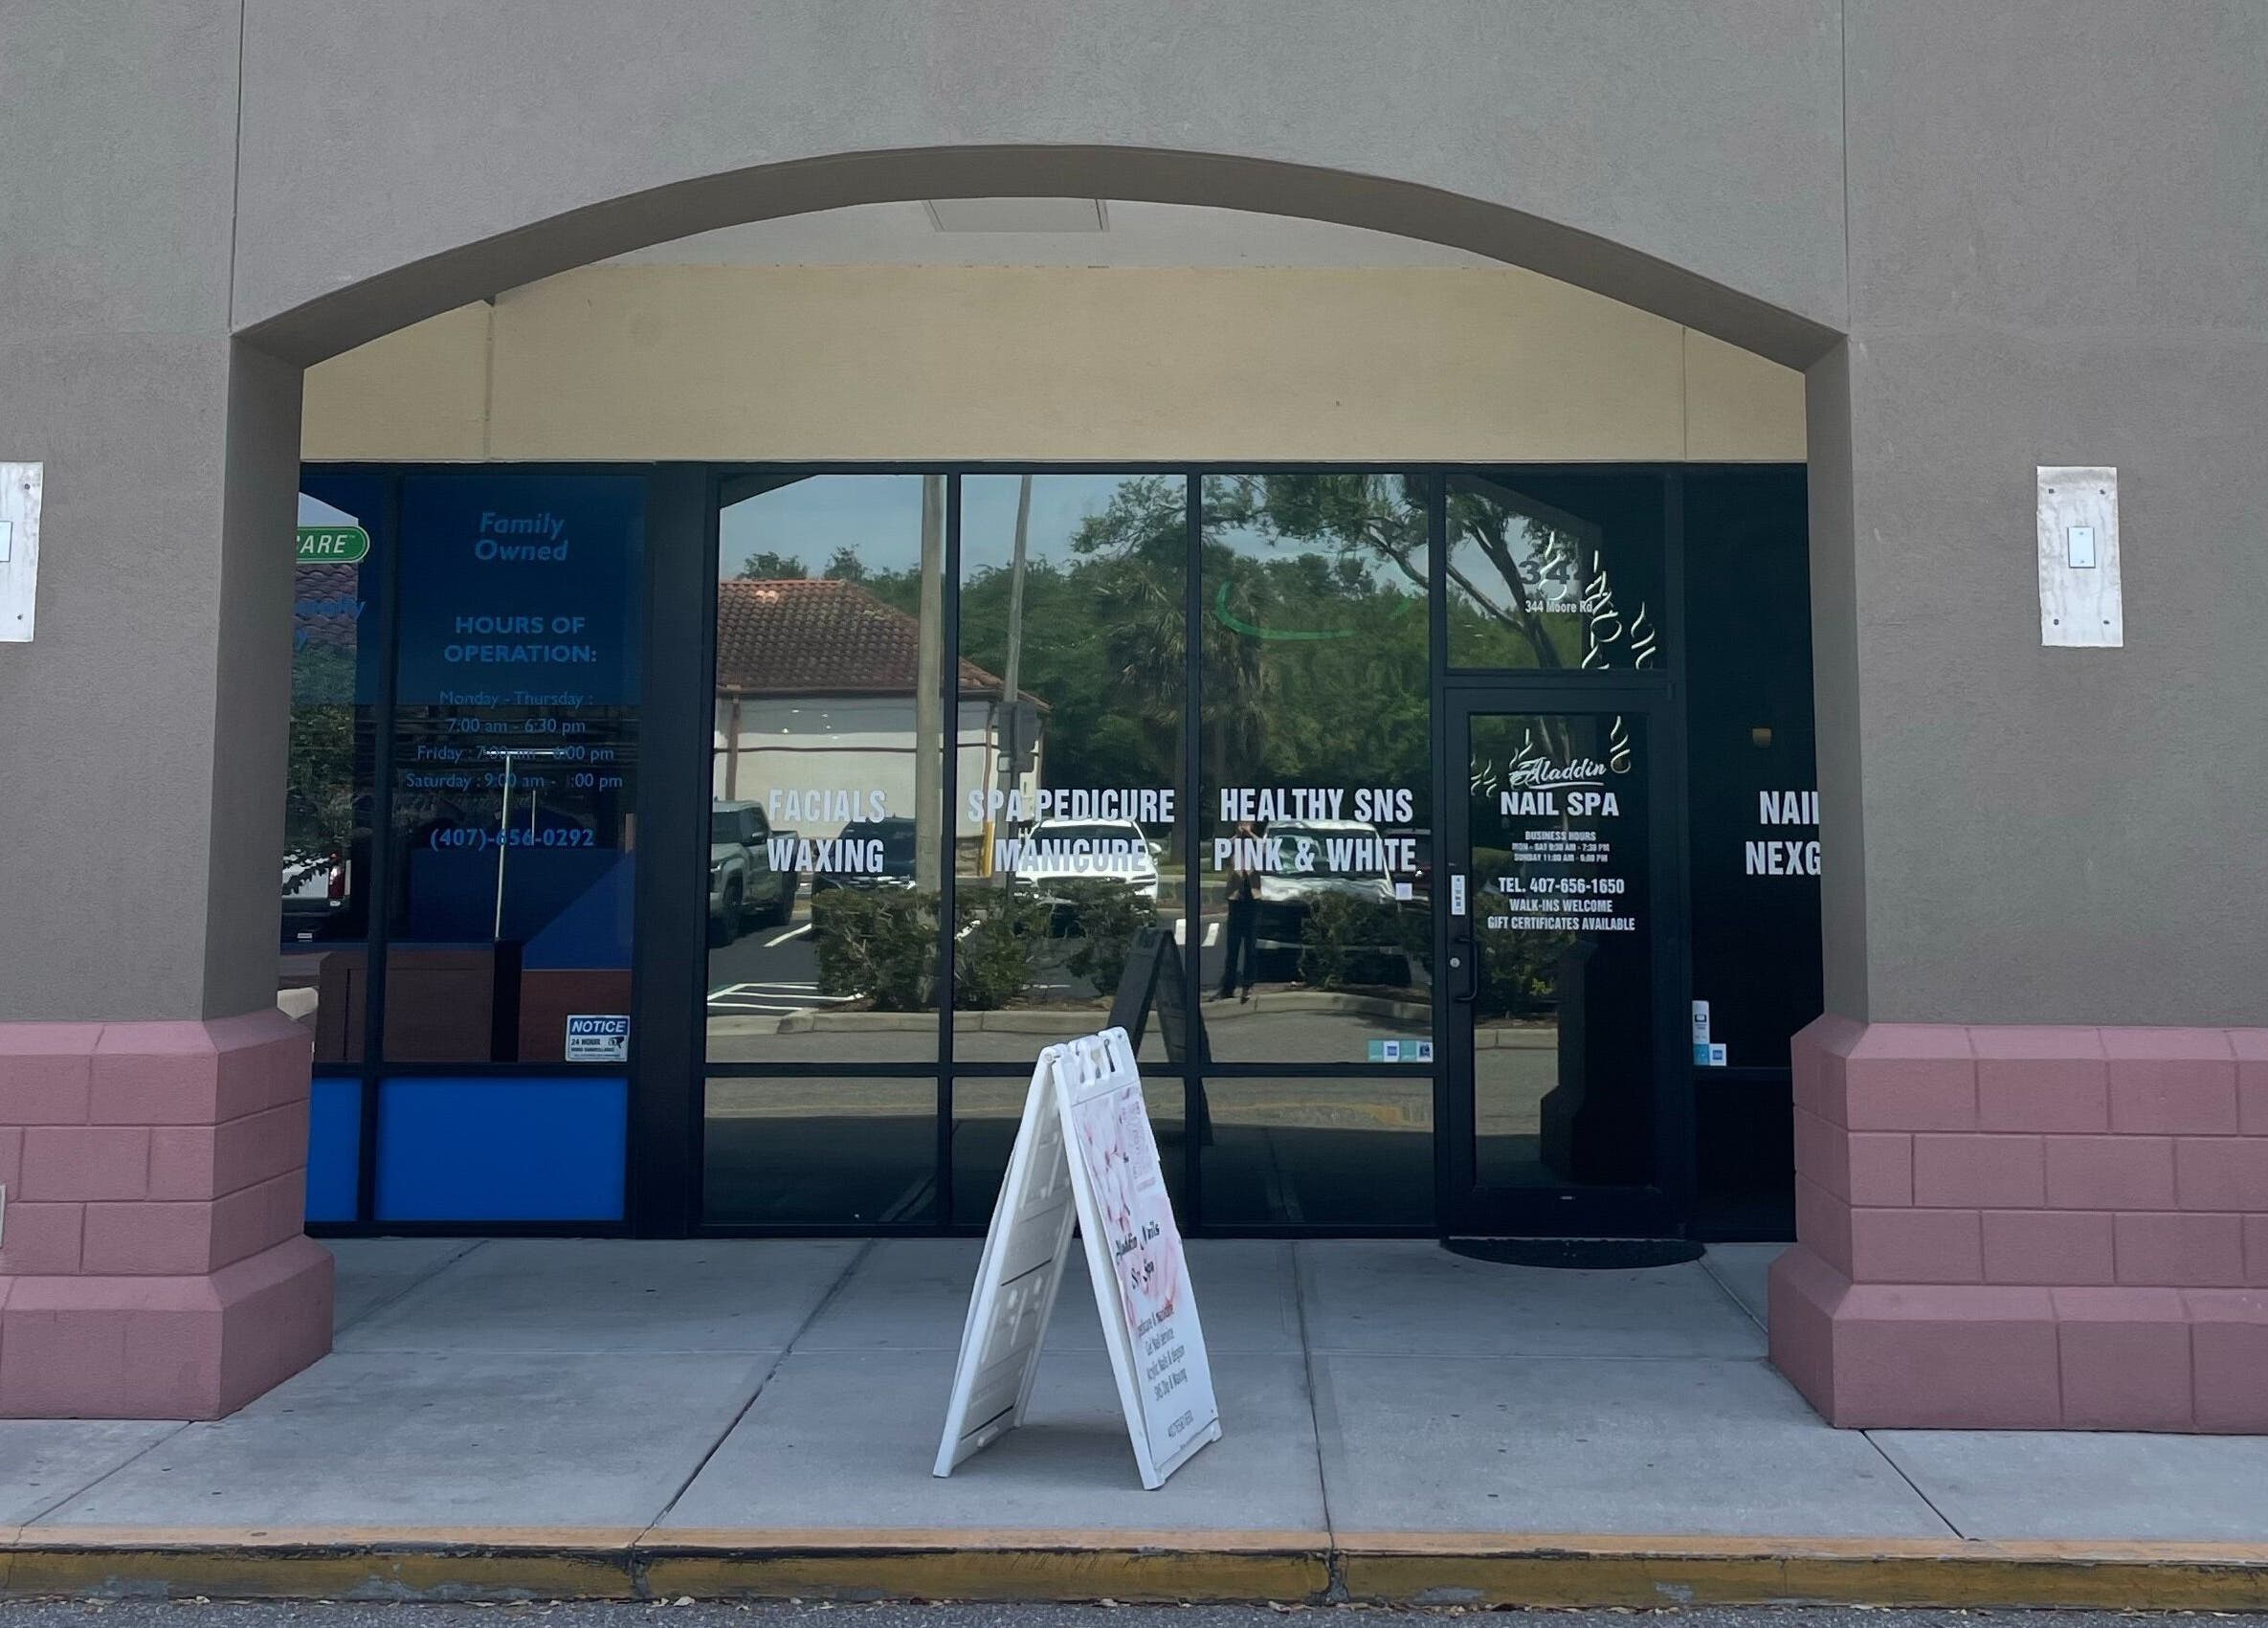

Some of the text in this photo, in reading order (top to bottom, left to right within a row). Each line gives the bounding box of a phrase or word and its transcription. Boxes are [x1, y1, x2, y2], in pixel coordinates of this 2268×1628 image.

[479, 511, 567, 541] Family
[296, 534, 348, 554] ARE
[476, 538, 569, 561] Owned
[1524, 600, 1593, 613] 344 Moore Rd
[455, 616, 586, 635] HOURS OF
[444, 644, 598, 663] OPERATION:
[438, 690, 499, 709] Monday
[514, 690, 585, 710] Thursday
[447, 718, 479, 734] 7:00
[484, 722, 507, 733] am
[524, 718, 557, 734] 6:30
[562, 721, 586, 737] pm
[416, 745, 463, 762] Friday
[589, 748, 614, 764] pm
[406, 772, 472, 792] Saturday
[485, 772, 517, 788] 9:00
[522, 775, 545, 788] am
[599, 775, 623, 792] pm
[1509, 757, 1607, 787] Aladdin
[767, 789, 886, 823] FACIALS
[967, 789, 1175, 823] SPA PEDICURE
[1220, 788, 1413, 823] HEALTHY SNS
[1501, 792, 1620, 816] NAIL SPA
[431, 827, 595, 852] (407)-656-0292
[1524, 831, 1596, 841] BUSINESS HOURS
[766, 838, 884, 873] WAXING
[994, 838, 1147, 873] MANICURE
[1214, 837, 1416, 872] PINK & WHITE
[1499, 877, 1625, 894] TEL. 407-656-1650
[1509, 898, 1613, 913] WALK-INS WELCOME
[1487, 916, 1635, 931] GIFT CERTIFICATES AVAILABLE
[571, 1020, 627, 1034] NOTICE
